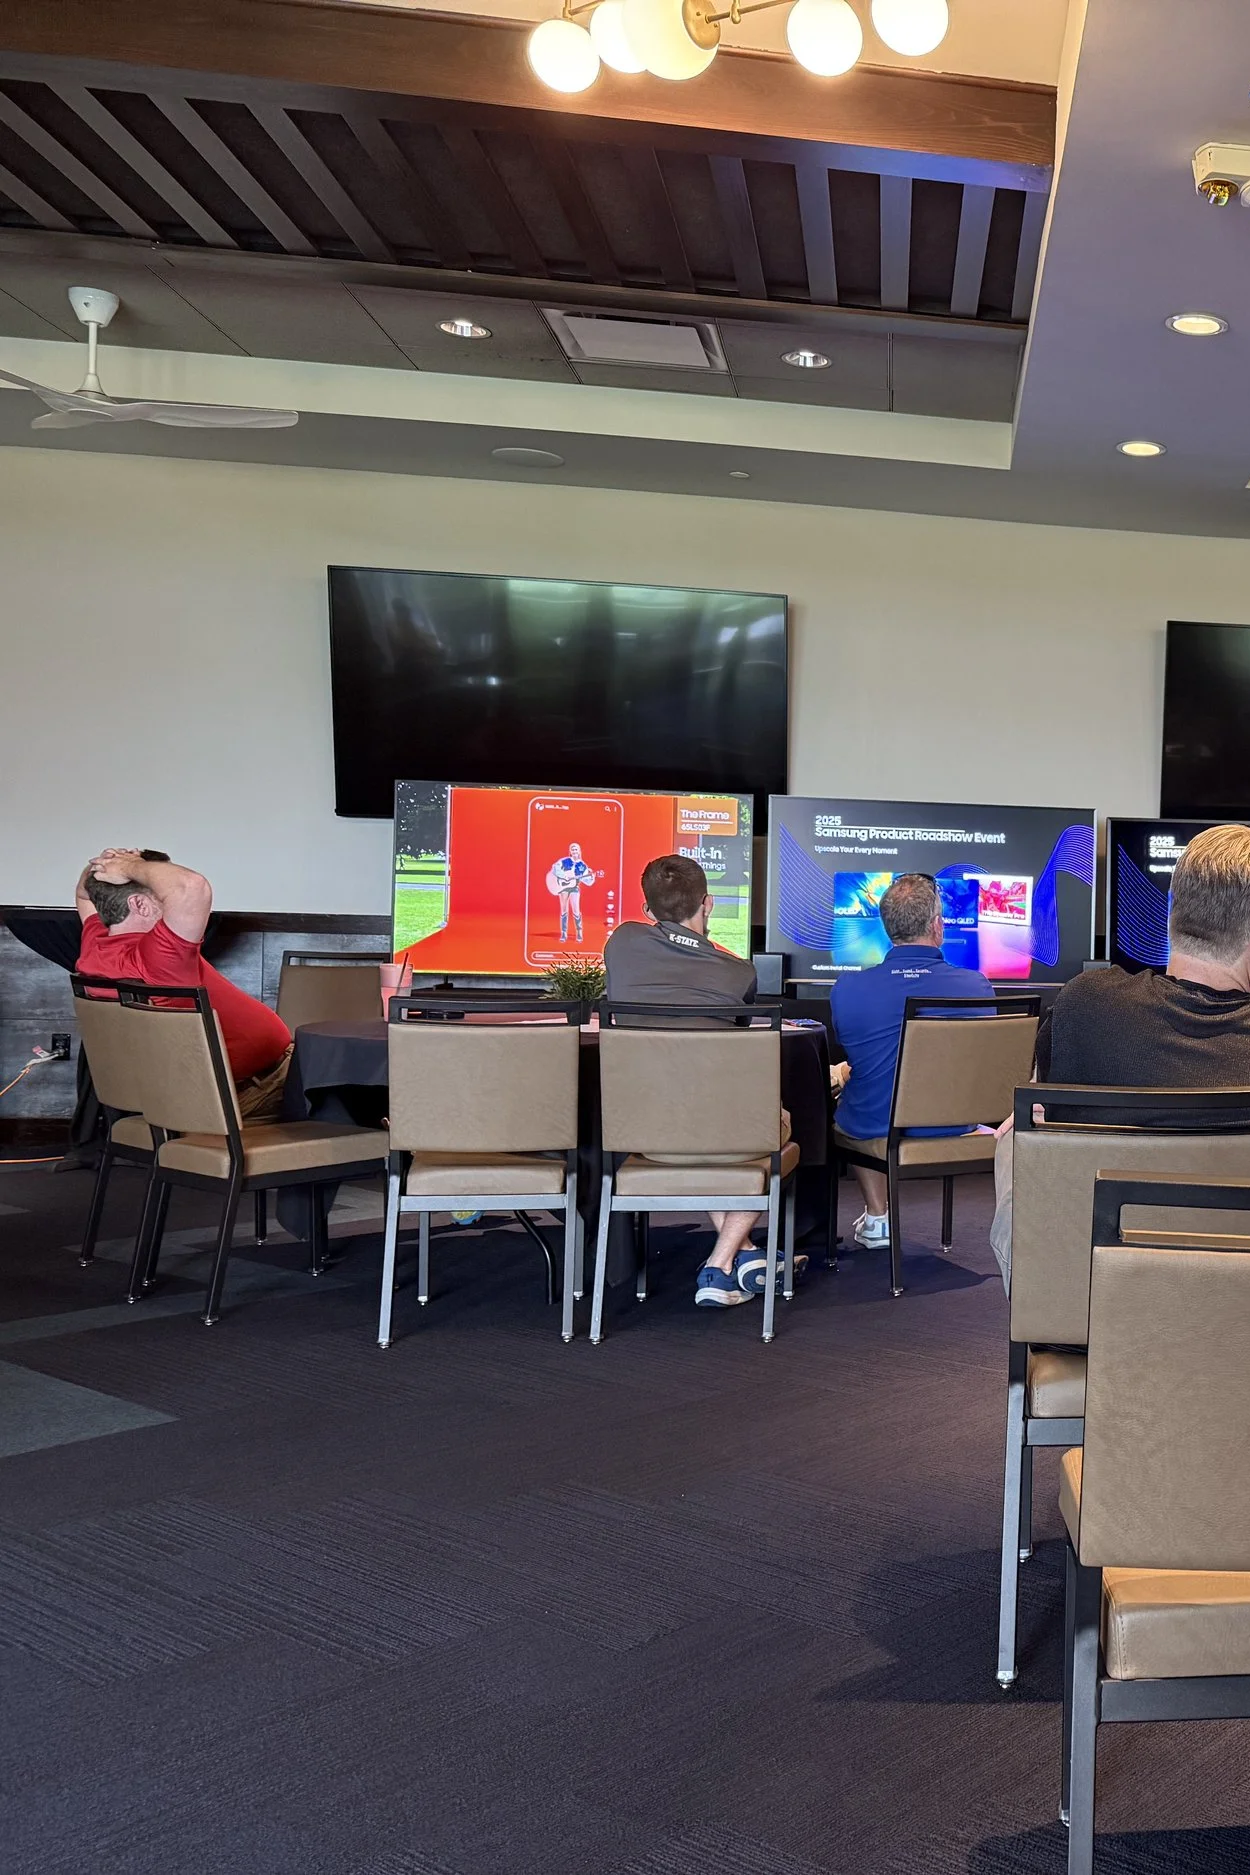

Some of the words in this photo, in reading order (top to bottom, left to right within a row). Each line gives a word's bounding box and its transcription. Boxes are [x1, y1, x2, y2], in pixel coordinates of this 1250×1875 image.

[680, 809, 698, 818] The
[699, 810, 730, 820] Frame
[815, 815, 842, 826] 2025
[815, 827, 868, 841] Samsung
[869, 828, 914, 840] Product
[914, 830, 973, 843] Roadshow
[974, 832, 1006, 844] Event
[1149, 836, 1175, 846] 2025
[679, 846, 722, 860] Built-in
[854, 846, 872, 855] Every
[956, 917, 975, 925] QLED
[669, 933, 700, 948] K-STATE
